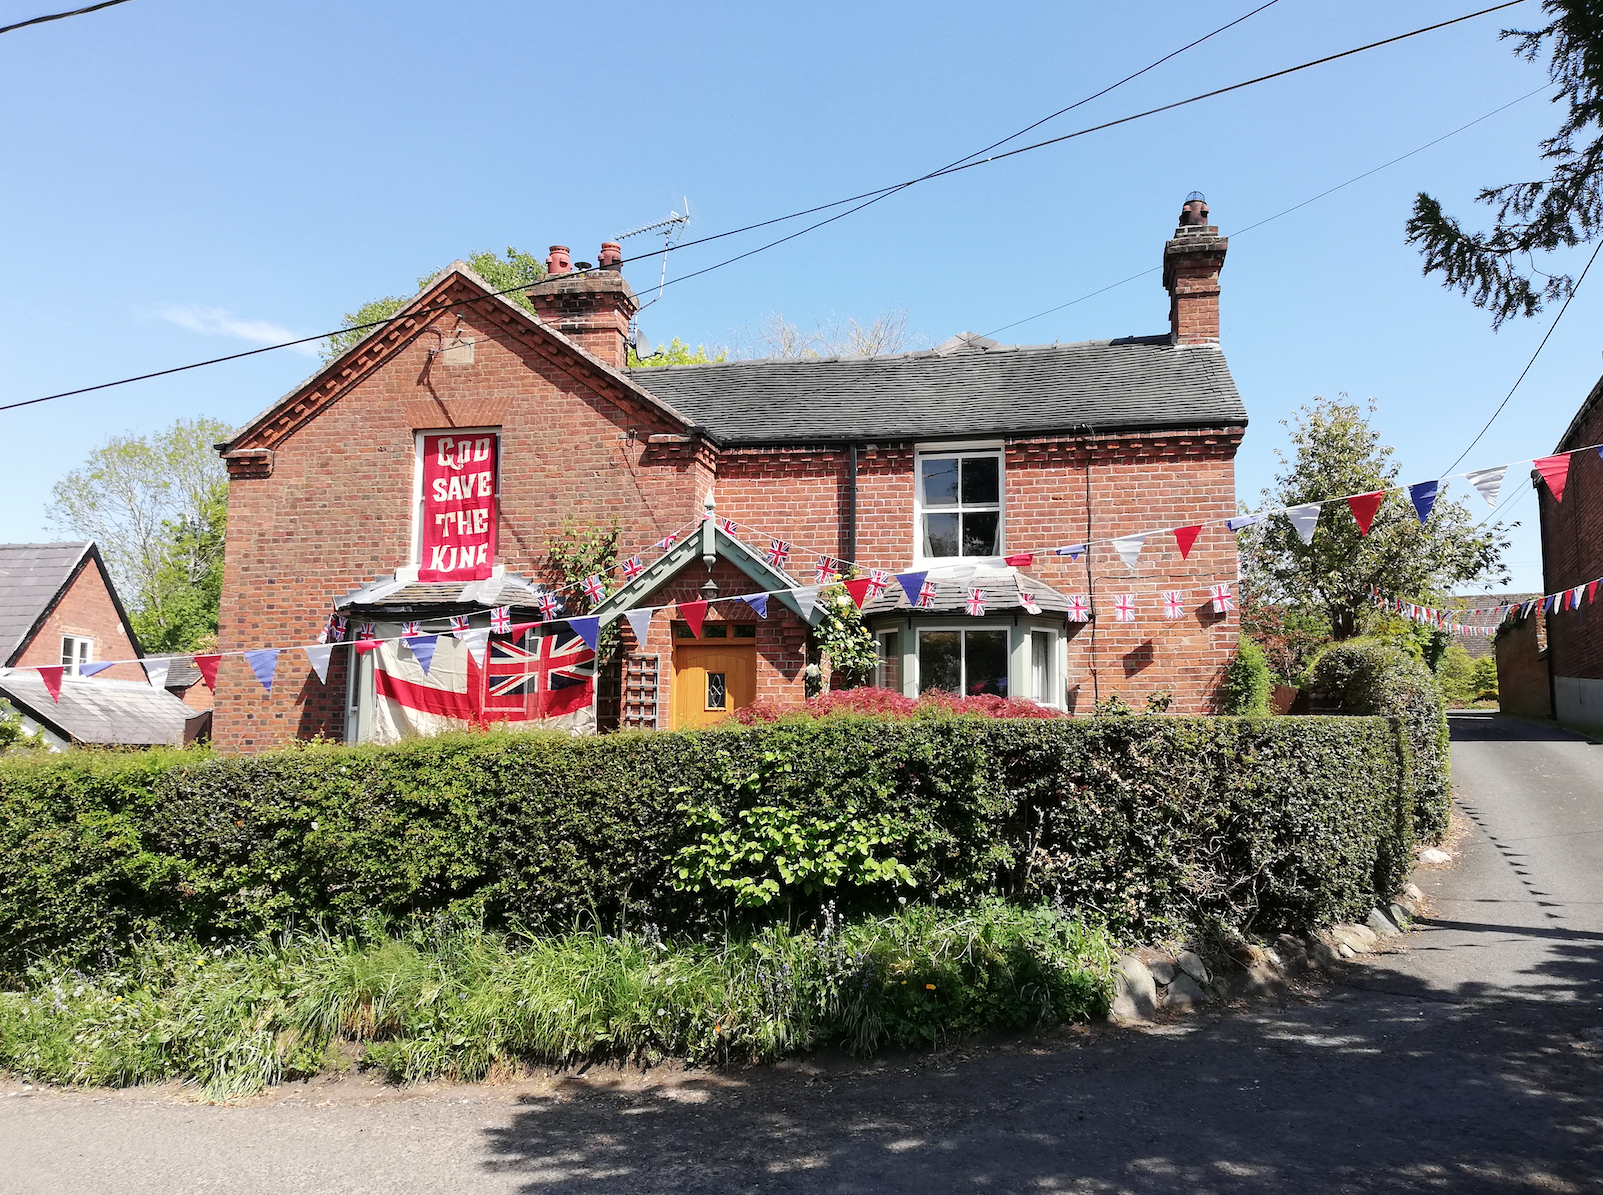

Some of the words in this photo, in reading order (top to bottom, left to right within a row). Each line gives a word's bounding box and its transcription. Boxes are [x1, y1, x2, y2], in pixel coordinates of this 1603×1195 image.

[437, 437, 491, 470] GOD
[432, 471, 492, 502] SAVE
[435, 508, 489, 538] THE
[429, 542, 489, 573] KING
